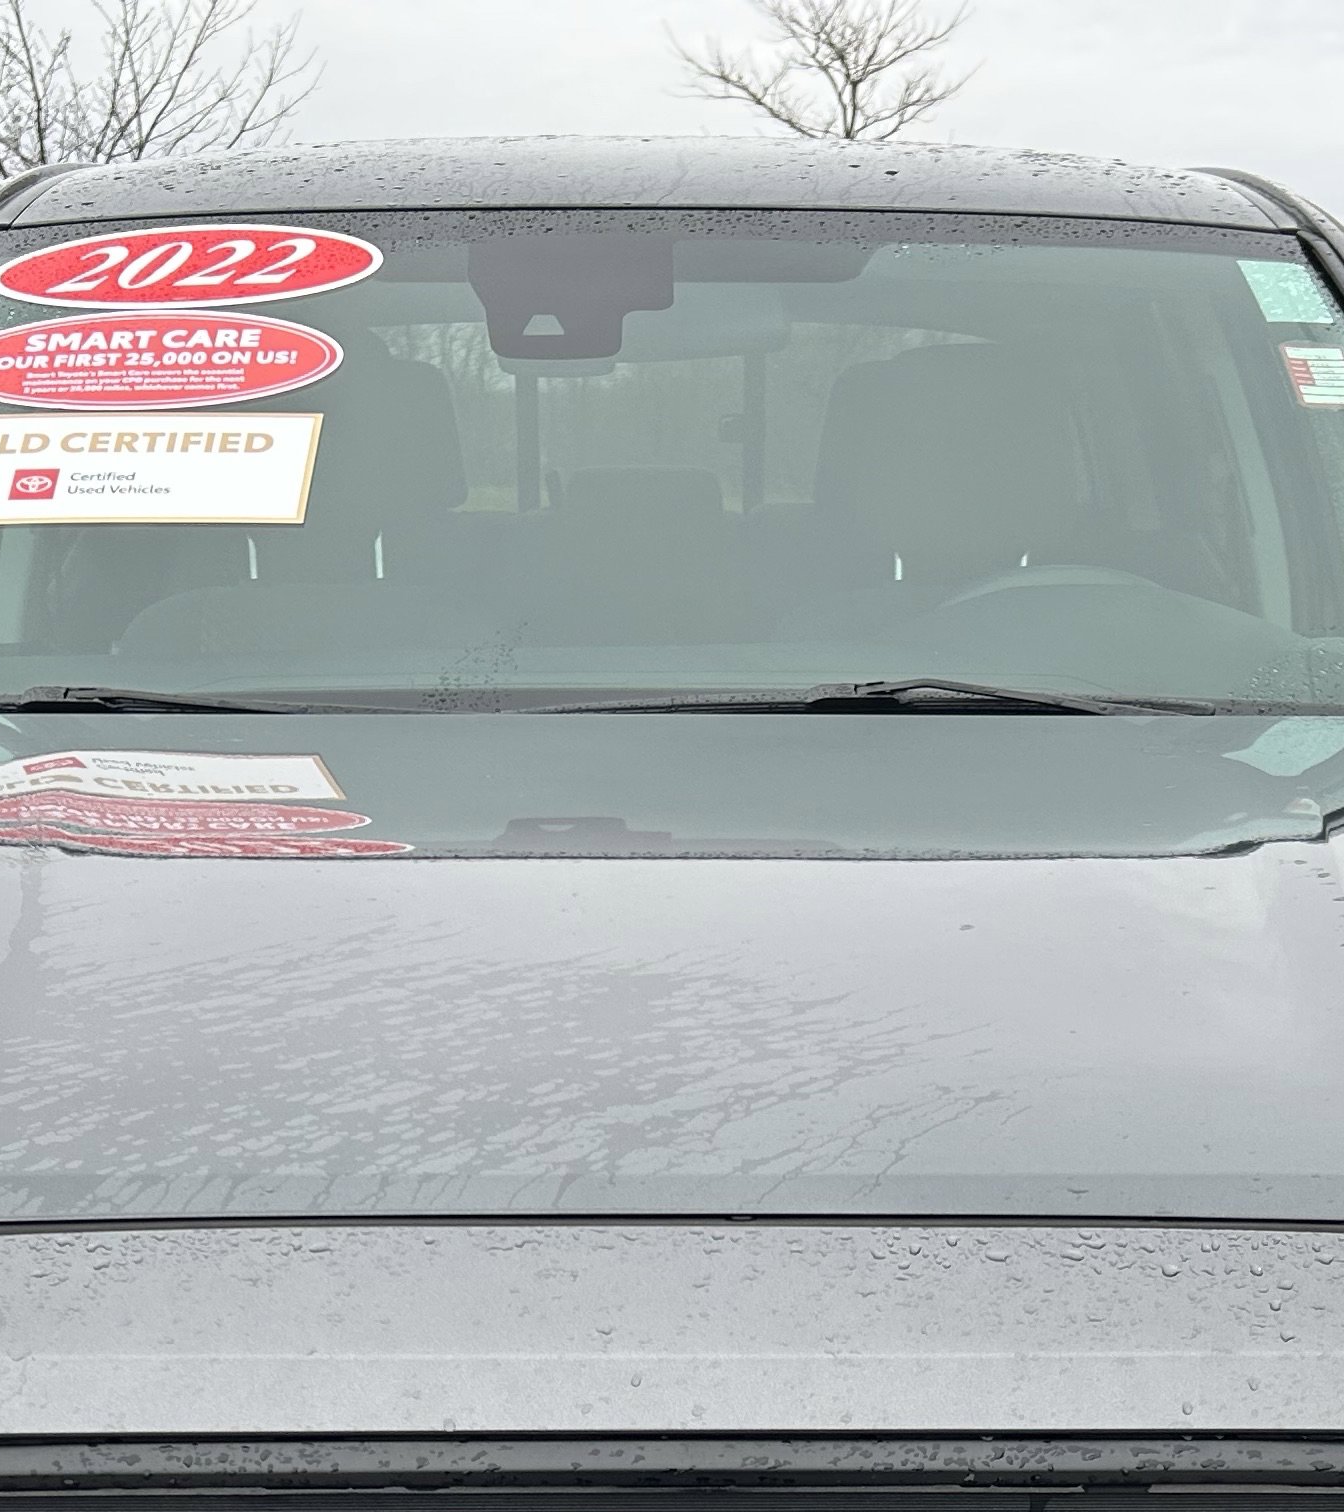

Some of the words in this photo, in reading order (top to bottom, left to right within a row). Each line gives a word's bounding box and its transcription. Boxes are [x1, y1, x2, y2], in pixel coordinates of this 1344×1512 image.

[45, 238, 317, 294] 2022
[24, 330, 157, 352] SMART
[162, 329, 262, 348] CARE
[53, 353, 122, 368] FIRST
[124, 351, 207, 367] 25,000
[211, 351, 251, 365] ON
[256, 351, 298, 364] US!
[60, 432, 274, 453] CERTIFIED
[70, 472, 136, 481] Certified
[67, 485, 106, 494] Used
[109, 484, 171, 494] Vehicles
